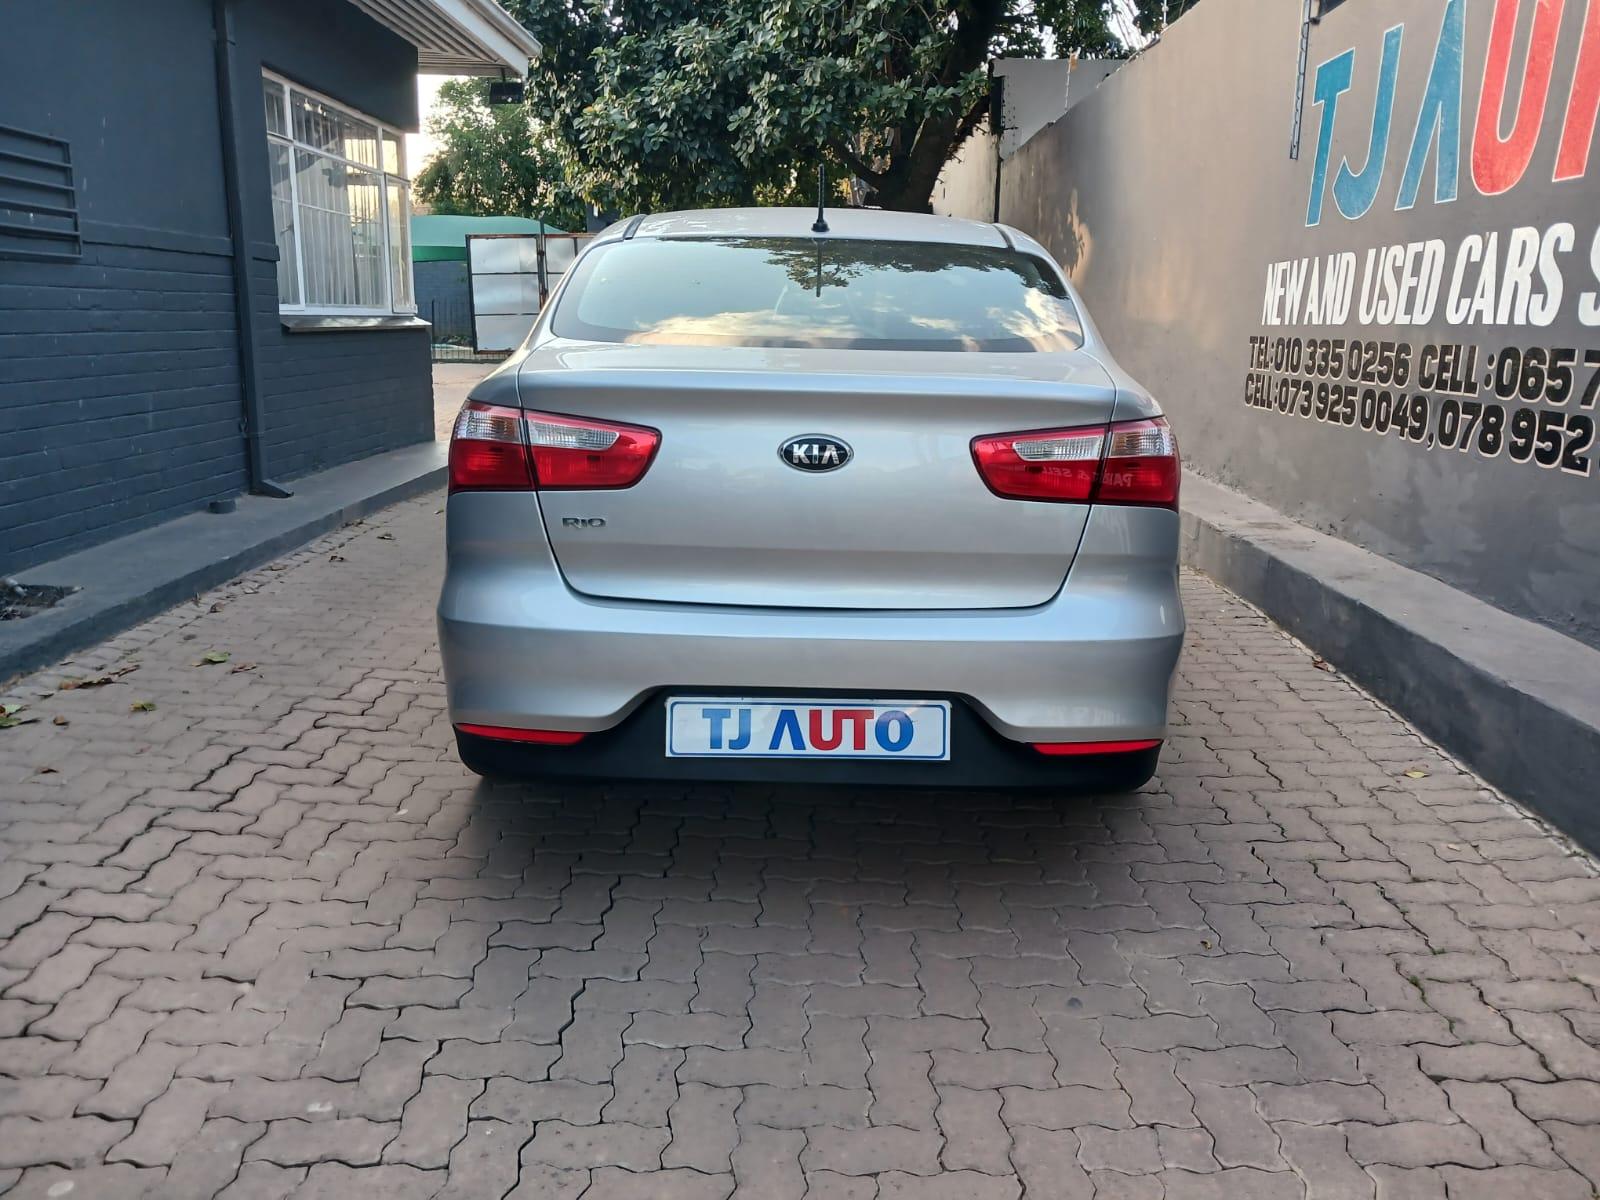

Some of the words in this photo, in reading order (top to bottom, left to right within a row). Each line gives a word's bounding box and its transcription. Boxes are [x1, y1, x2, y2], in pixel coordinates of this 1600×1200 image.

[1261, 257, 1309, 326] NEW
[1303, 252, 1357, 325] AND
[1358, 239, 1447, 326] USED
[1446, 222, 1576, 327] CARS
[1304, 338, 1346, 381] 335
[1347, 340, 1413, 389] 0256
[1315, 382, 1358, 428] 925
[1508, 407, 1595, 478] 952
[792, 444, 840, 465] KIA
[562, 517, 606, 529] RIO
[702, 708, 750, 750] TJ
[768, 709, 914, 752] AUTO
